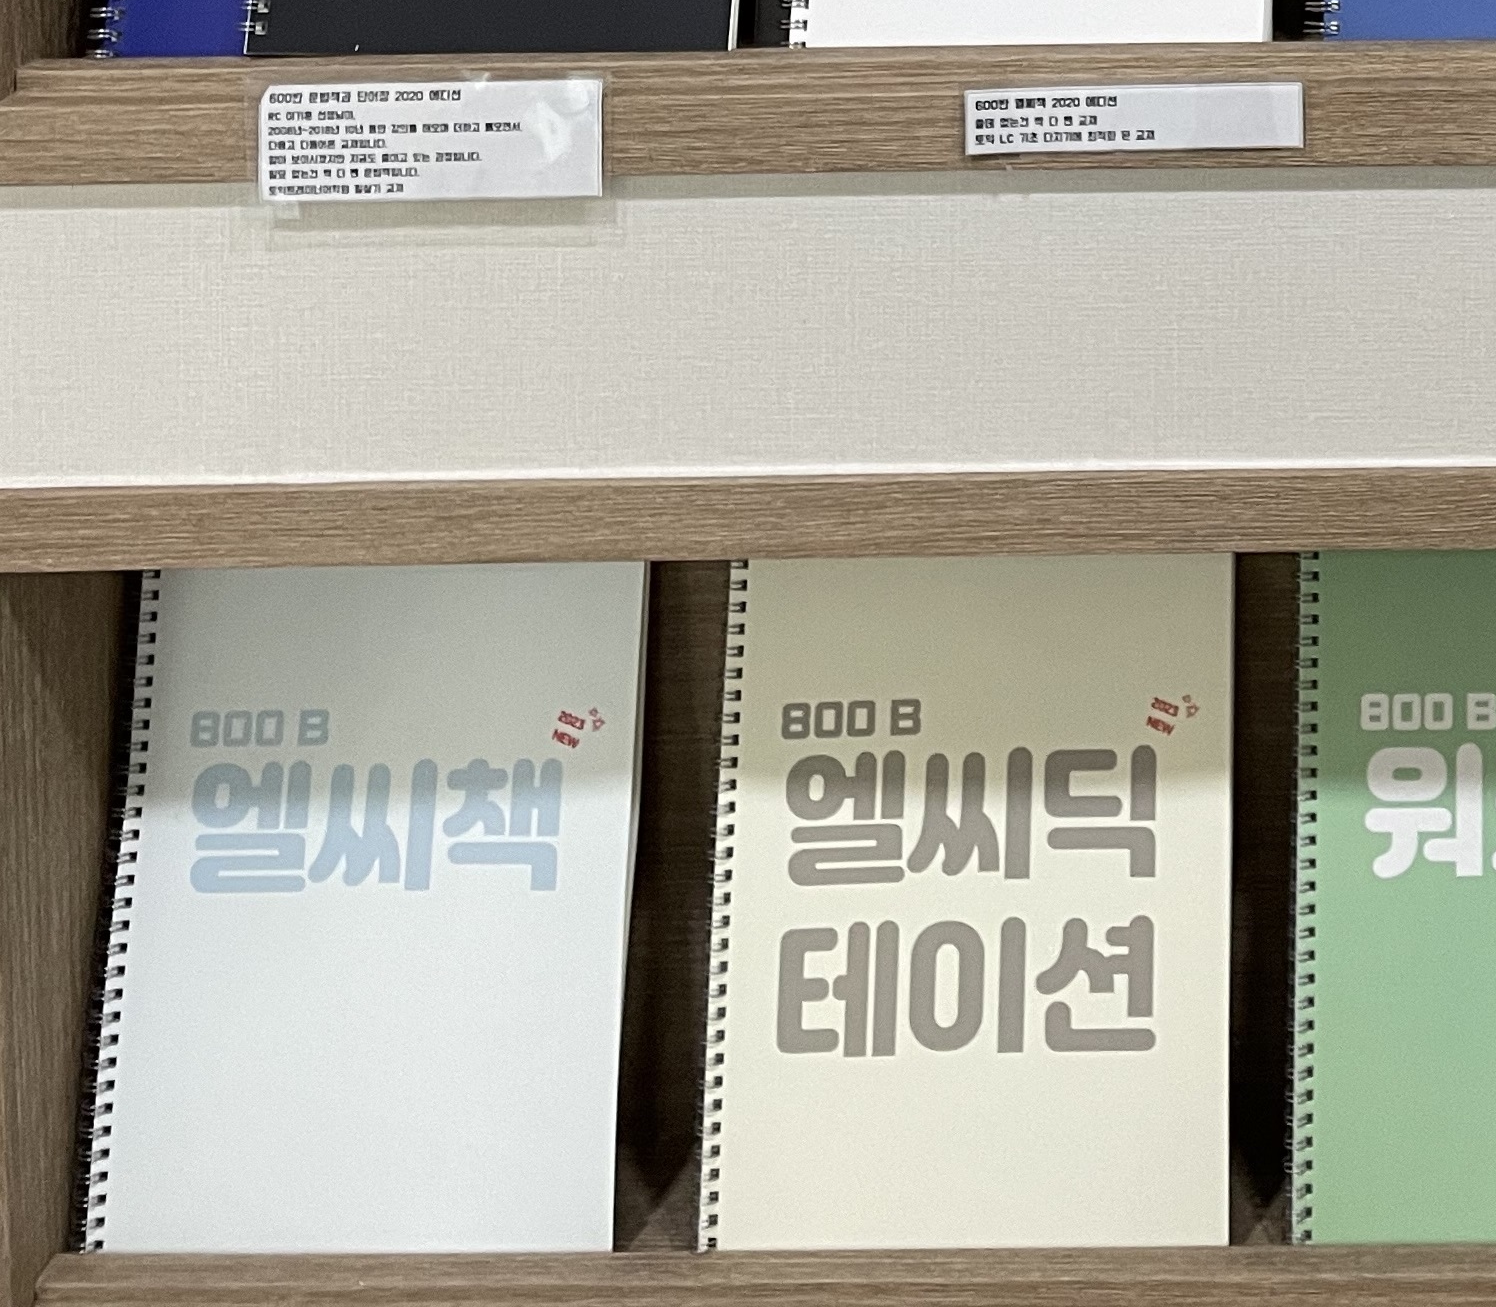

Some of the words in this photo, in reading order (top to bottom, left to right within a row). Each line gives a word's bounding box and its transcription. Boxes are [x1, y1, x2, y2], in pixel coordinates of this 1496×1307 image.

[395, 90, 424, 102] 2020
[1051, 97, 1081, 109] 2020
[999, 133, 1014, 144] LC
[189, 709, 284, 748] 800
[297, 709, 330, 747] B
[781, 699, 876, 740] 800
[890, 698, 922, 736] B
[1360, 692, 1454, 731] 800
[189, 757, 563, 894] 엘씨책
[785, 744, 1157, 887] 엘씨딕
[776, 914, 1157, 1057] 테이션
